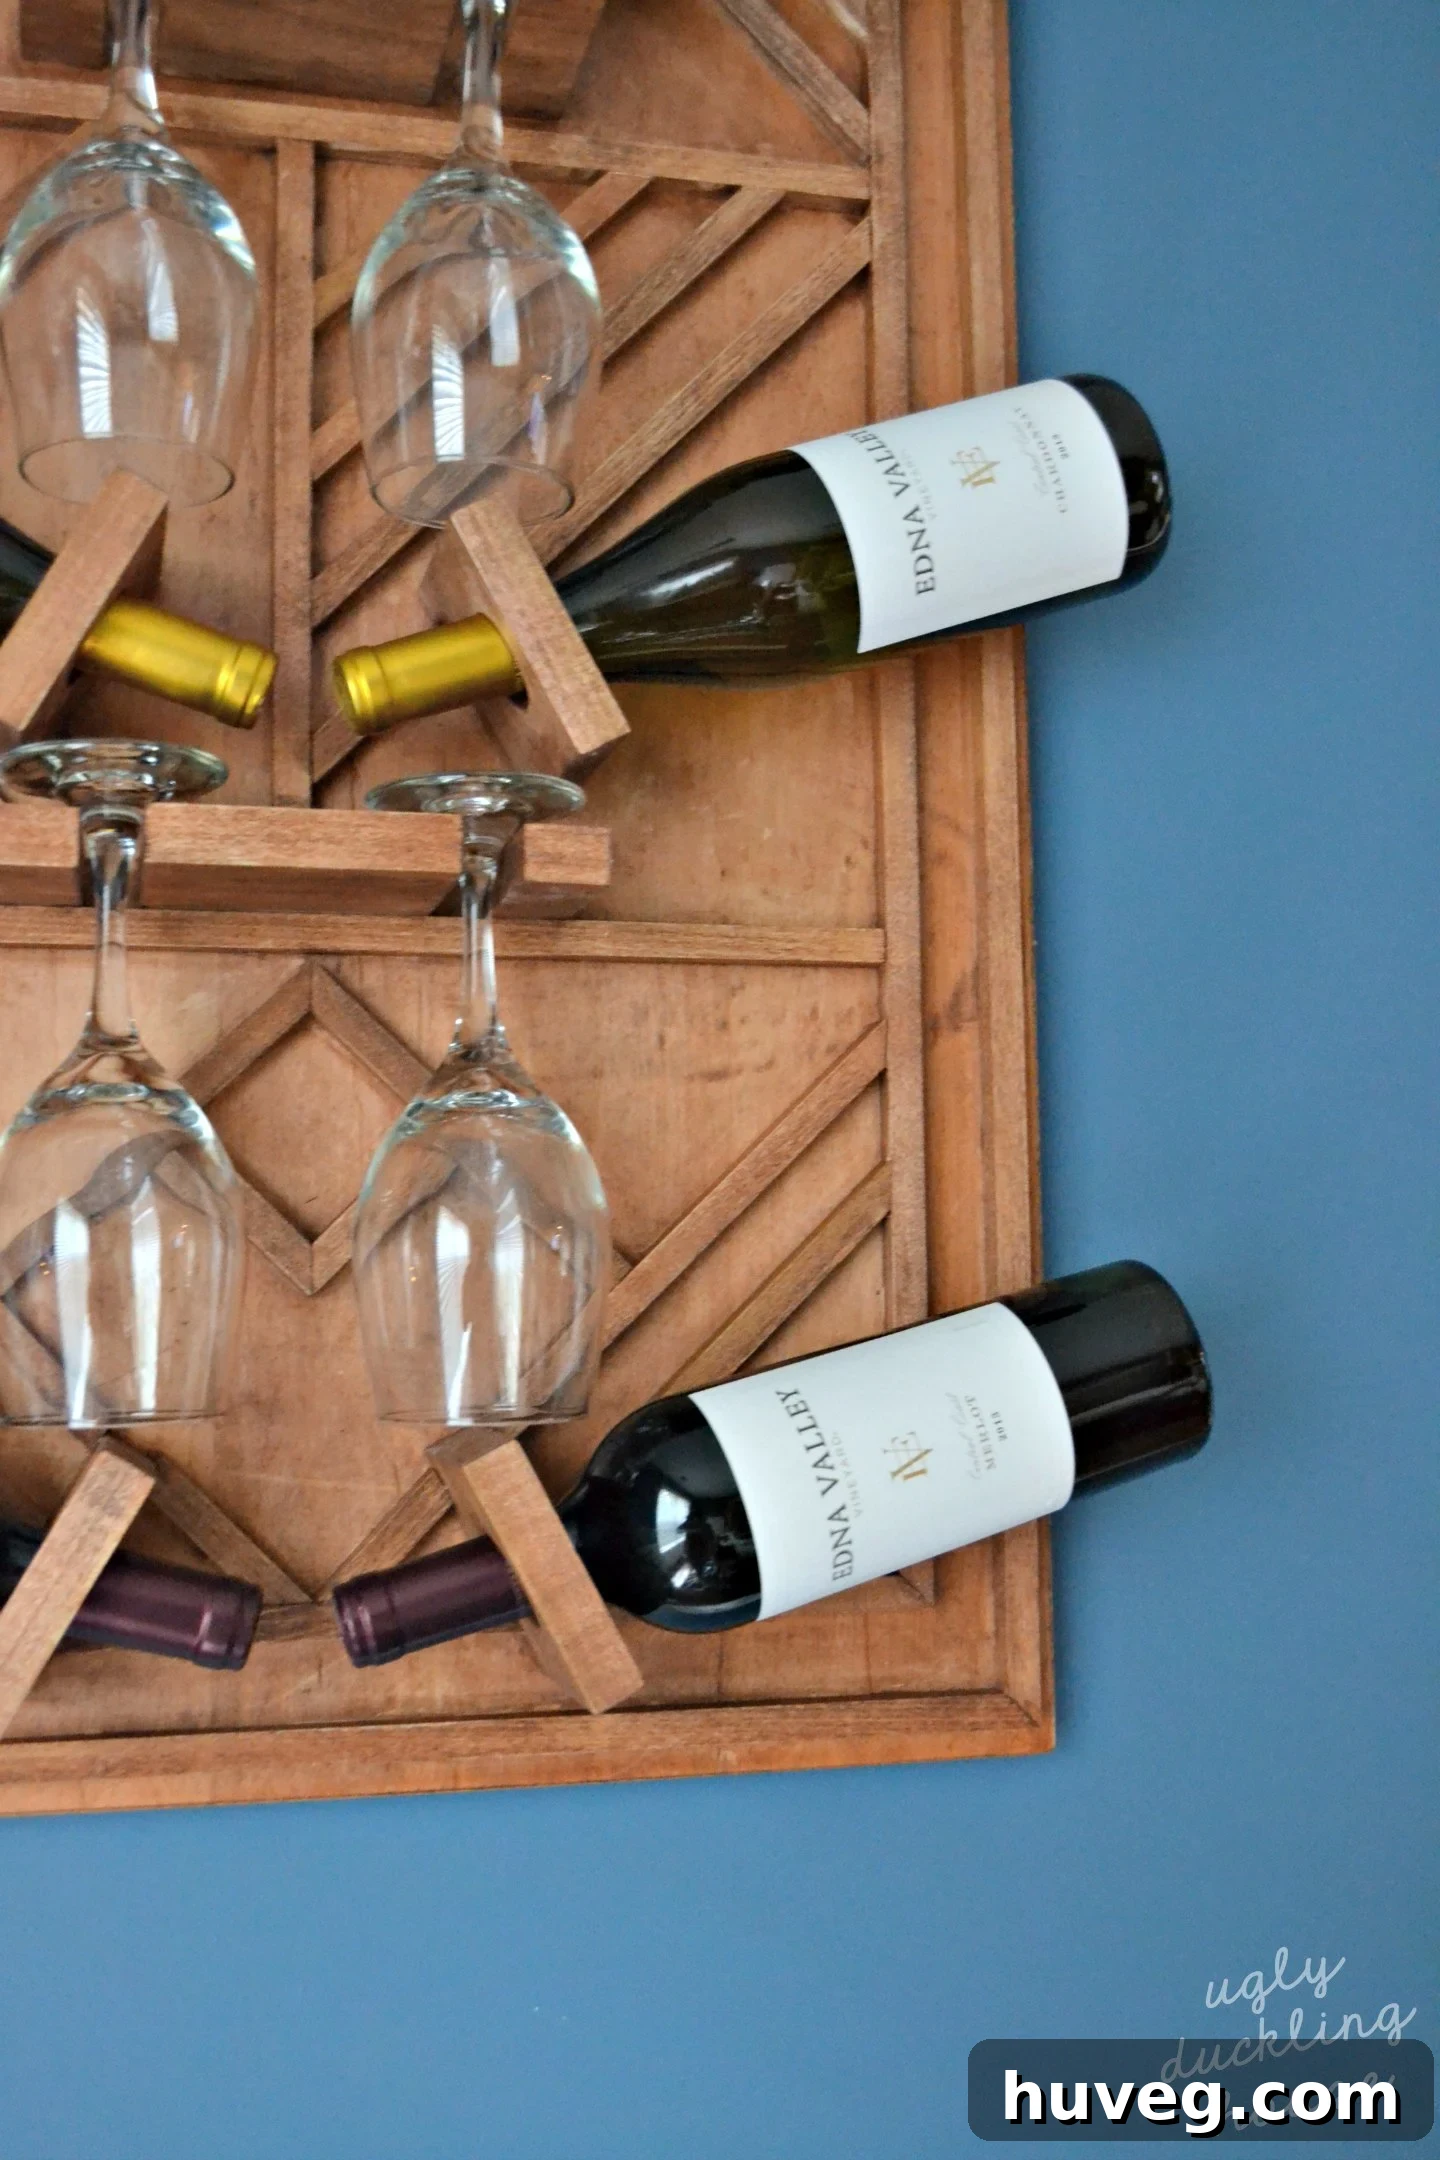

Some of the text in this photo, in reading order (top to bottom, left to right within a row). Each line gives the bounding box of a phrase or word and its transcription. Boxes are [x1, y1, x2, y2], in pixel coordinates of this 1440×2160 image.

[902, 504, 936, 595] EDNA
[964, 1394, 998, 1471] MERLOT
[775, 1387, 854, 1581] EDNA VALLEY
